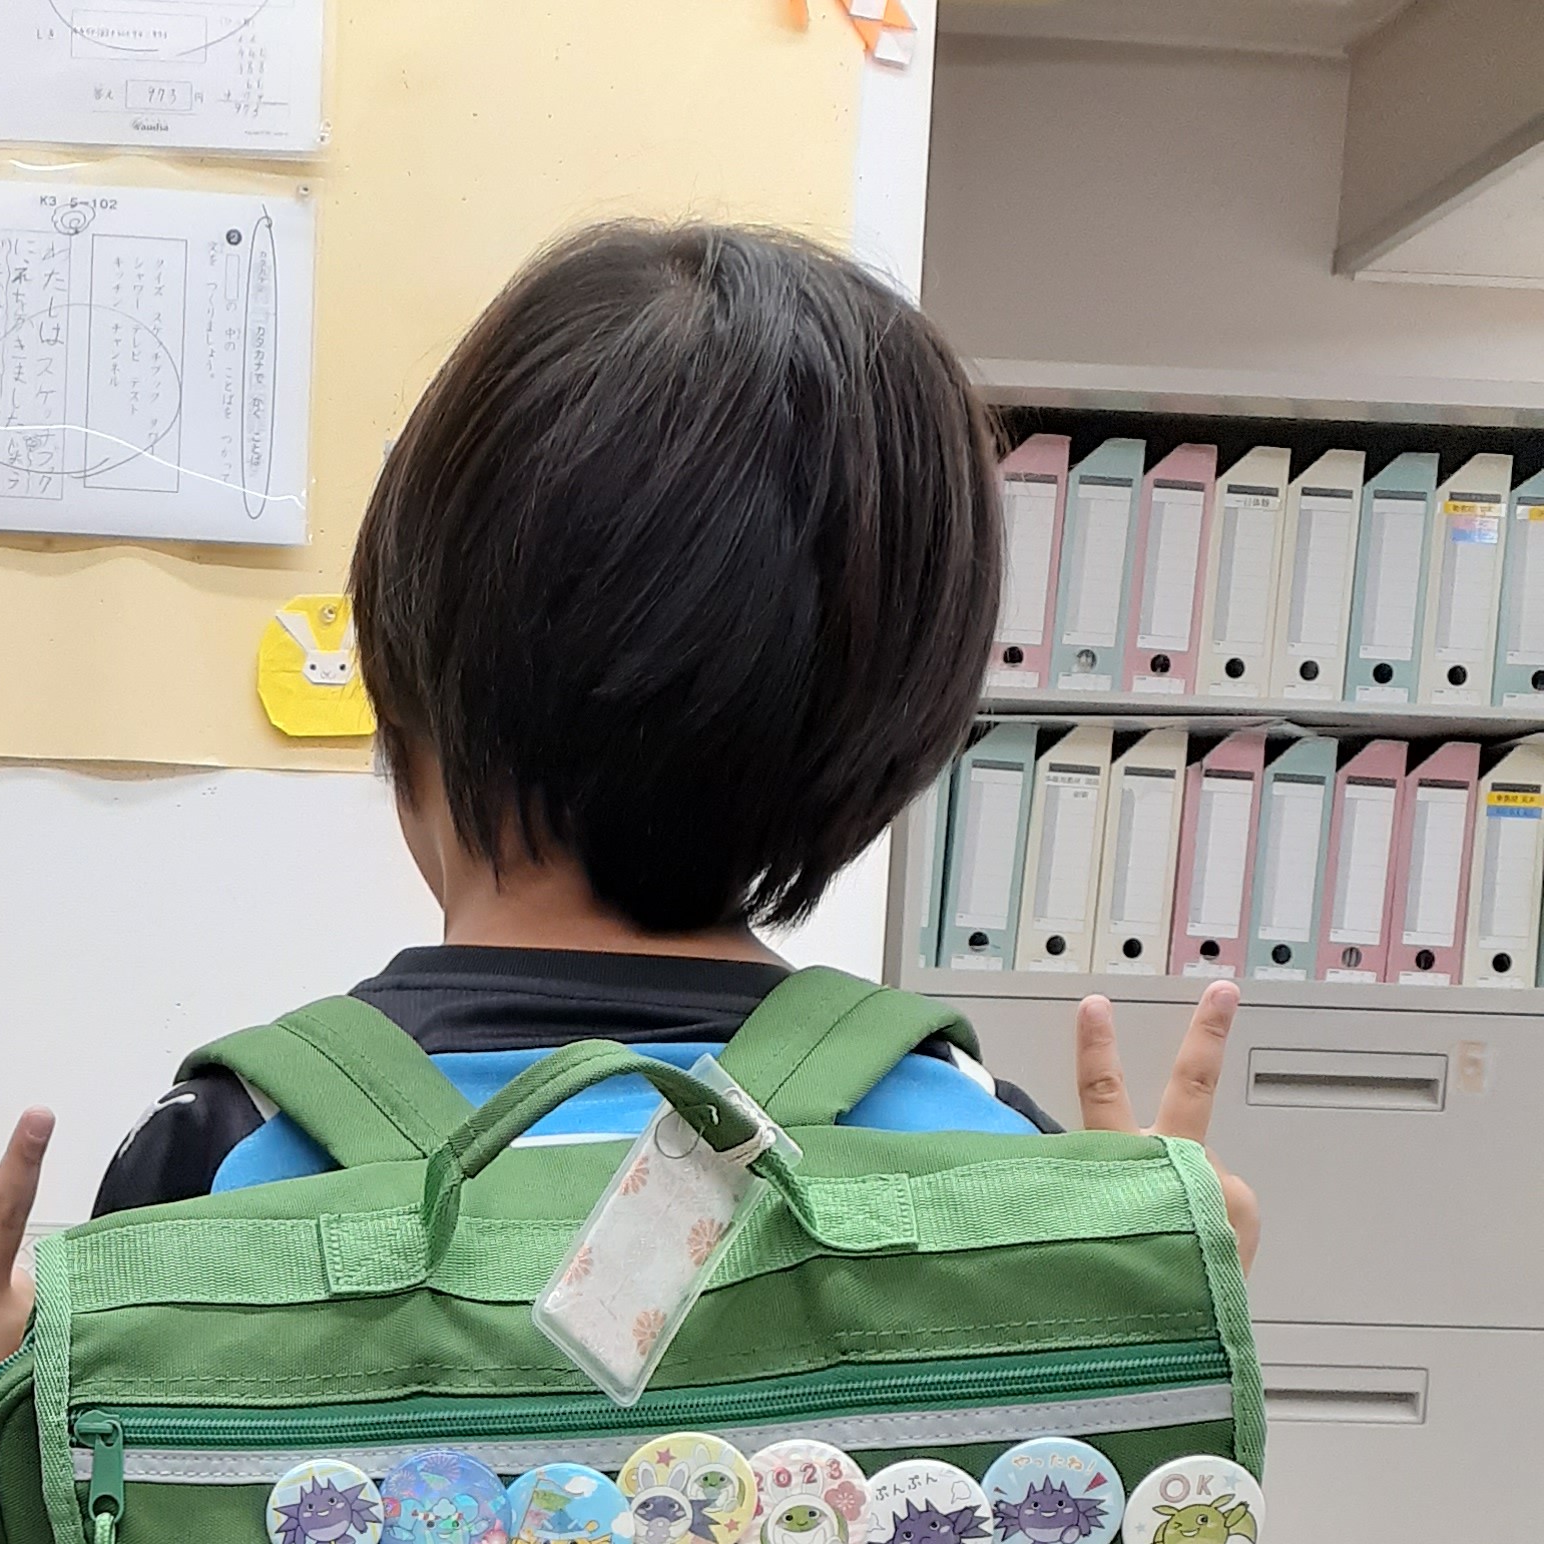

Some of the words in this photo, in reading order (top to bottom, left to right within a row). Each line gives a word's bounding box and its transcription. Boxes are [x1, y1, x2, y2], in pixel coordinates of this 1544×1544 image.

[39, 195, 57, 206] K3
[875, 1472, 938, 1501] ぷんぷん
[1159, 1473, 1214, 1503] OK
